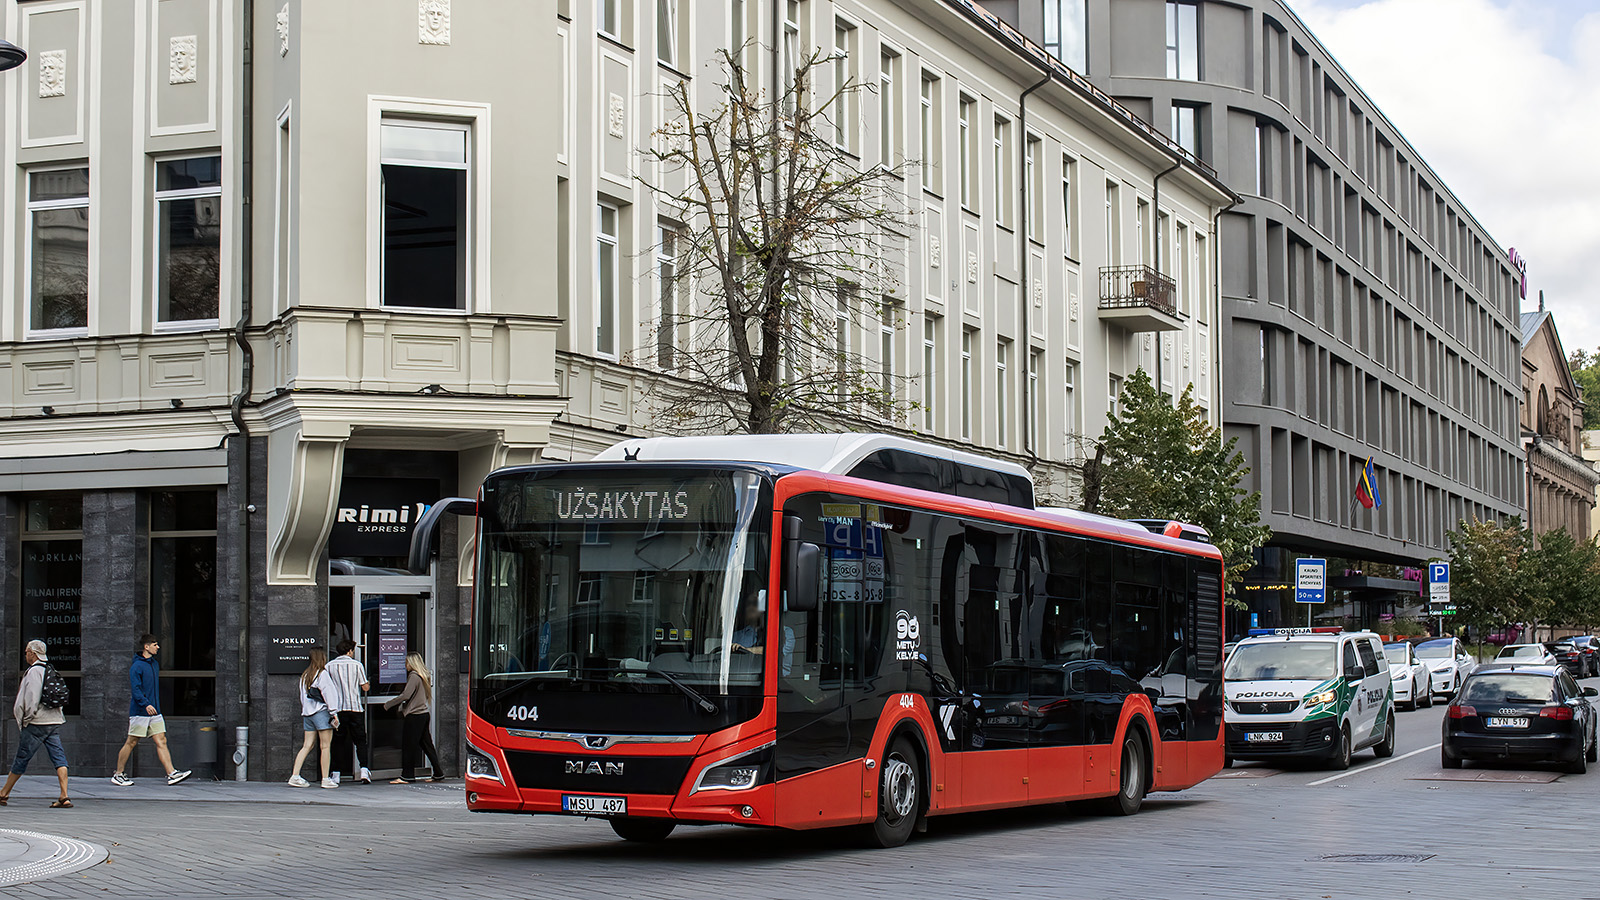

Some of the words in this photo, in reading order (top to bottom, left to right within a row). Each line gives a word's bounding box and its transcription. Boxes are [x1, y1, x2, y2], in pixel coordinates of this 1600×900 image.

[558, 487, 688, 518] UŽSAKYTAS
[836, 516, 853, 526] MAN
[1434, 566, 1445, 581] P
[25, 588, 55, 597] PILNAI
[44, 601, 74, 610] BIURAI
[32, 616, 44, 624] SU
[47, 615, 82, 624] BALDAI
[47, 637, 62, 645] 614
[64, 637, 80, 645] 559
[896, 641, 915, 651] METŲ
[896, 651, 918, 660] KELYJE
[900, 694, 914, 708] 404
[507, 705, 538, 721] 404
[565, 760, 624, 775] MAN
[570, 798, 594, 810] MSU
[603, 800, 623, 811] 487
